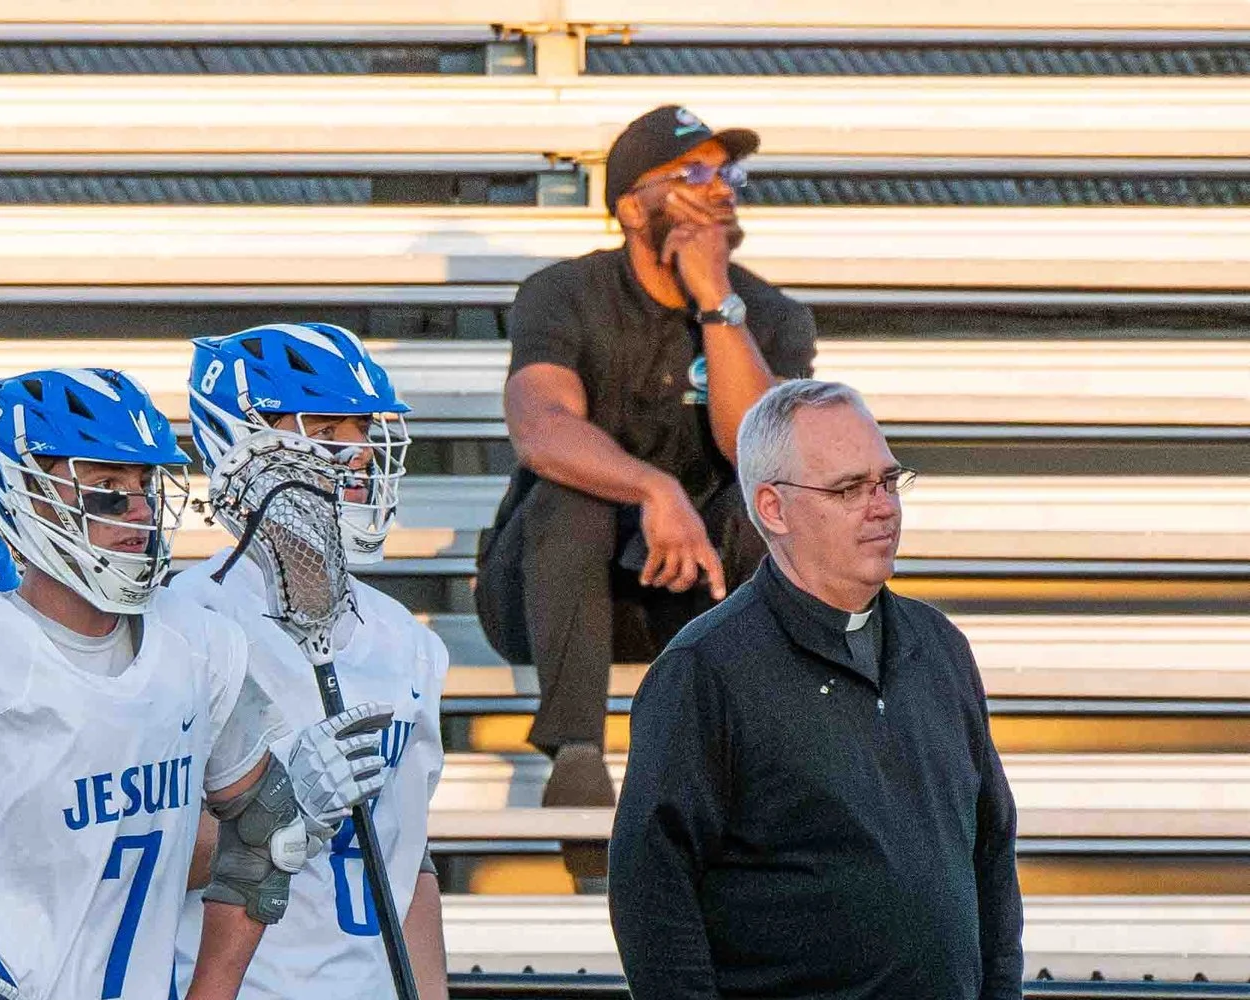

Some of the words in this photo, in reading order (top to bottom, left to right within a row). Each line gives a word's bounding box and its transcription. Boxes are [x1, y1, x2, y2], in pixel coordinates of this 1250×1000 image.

[201, 360, 224, 395] 8
[62, 755, 193, 831] JESUIT
[101, 830, 164, 1000] 7
